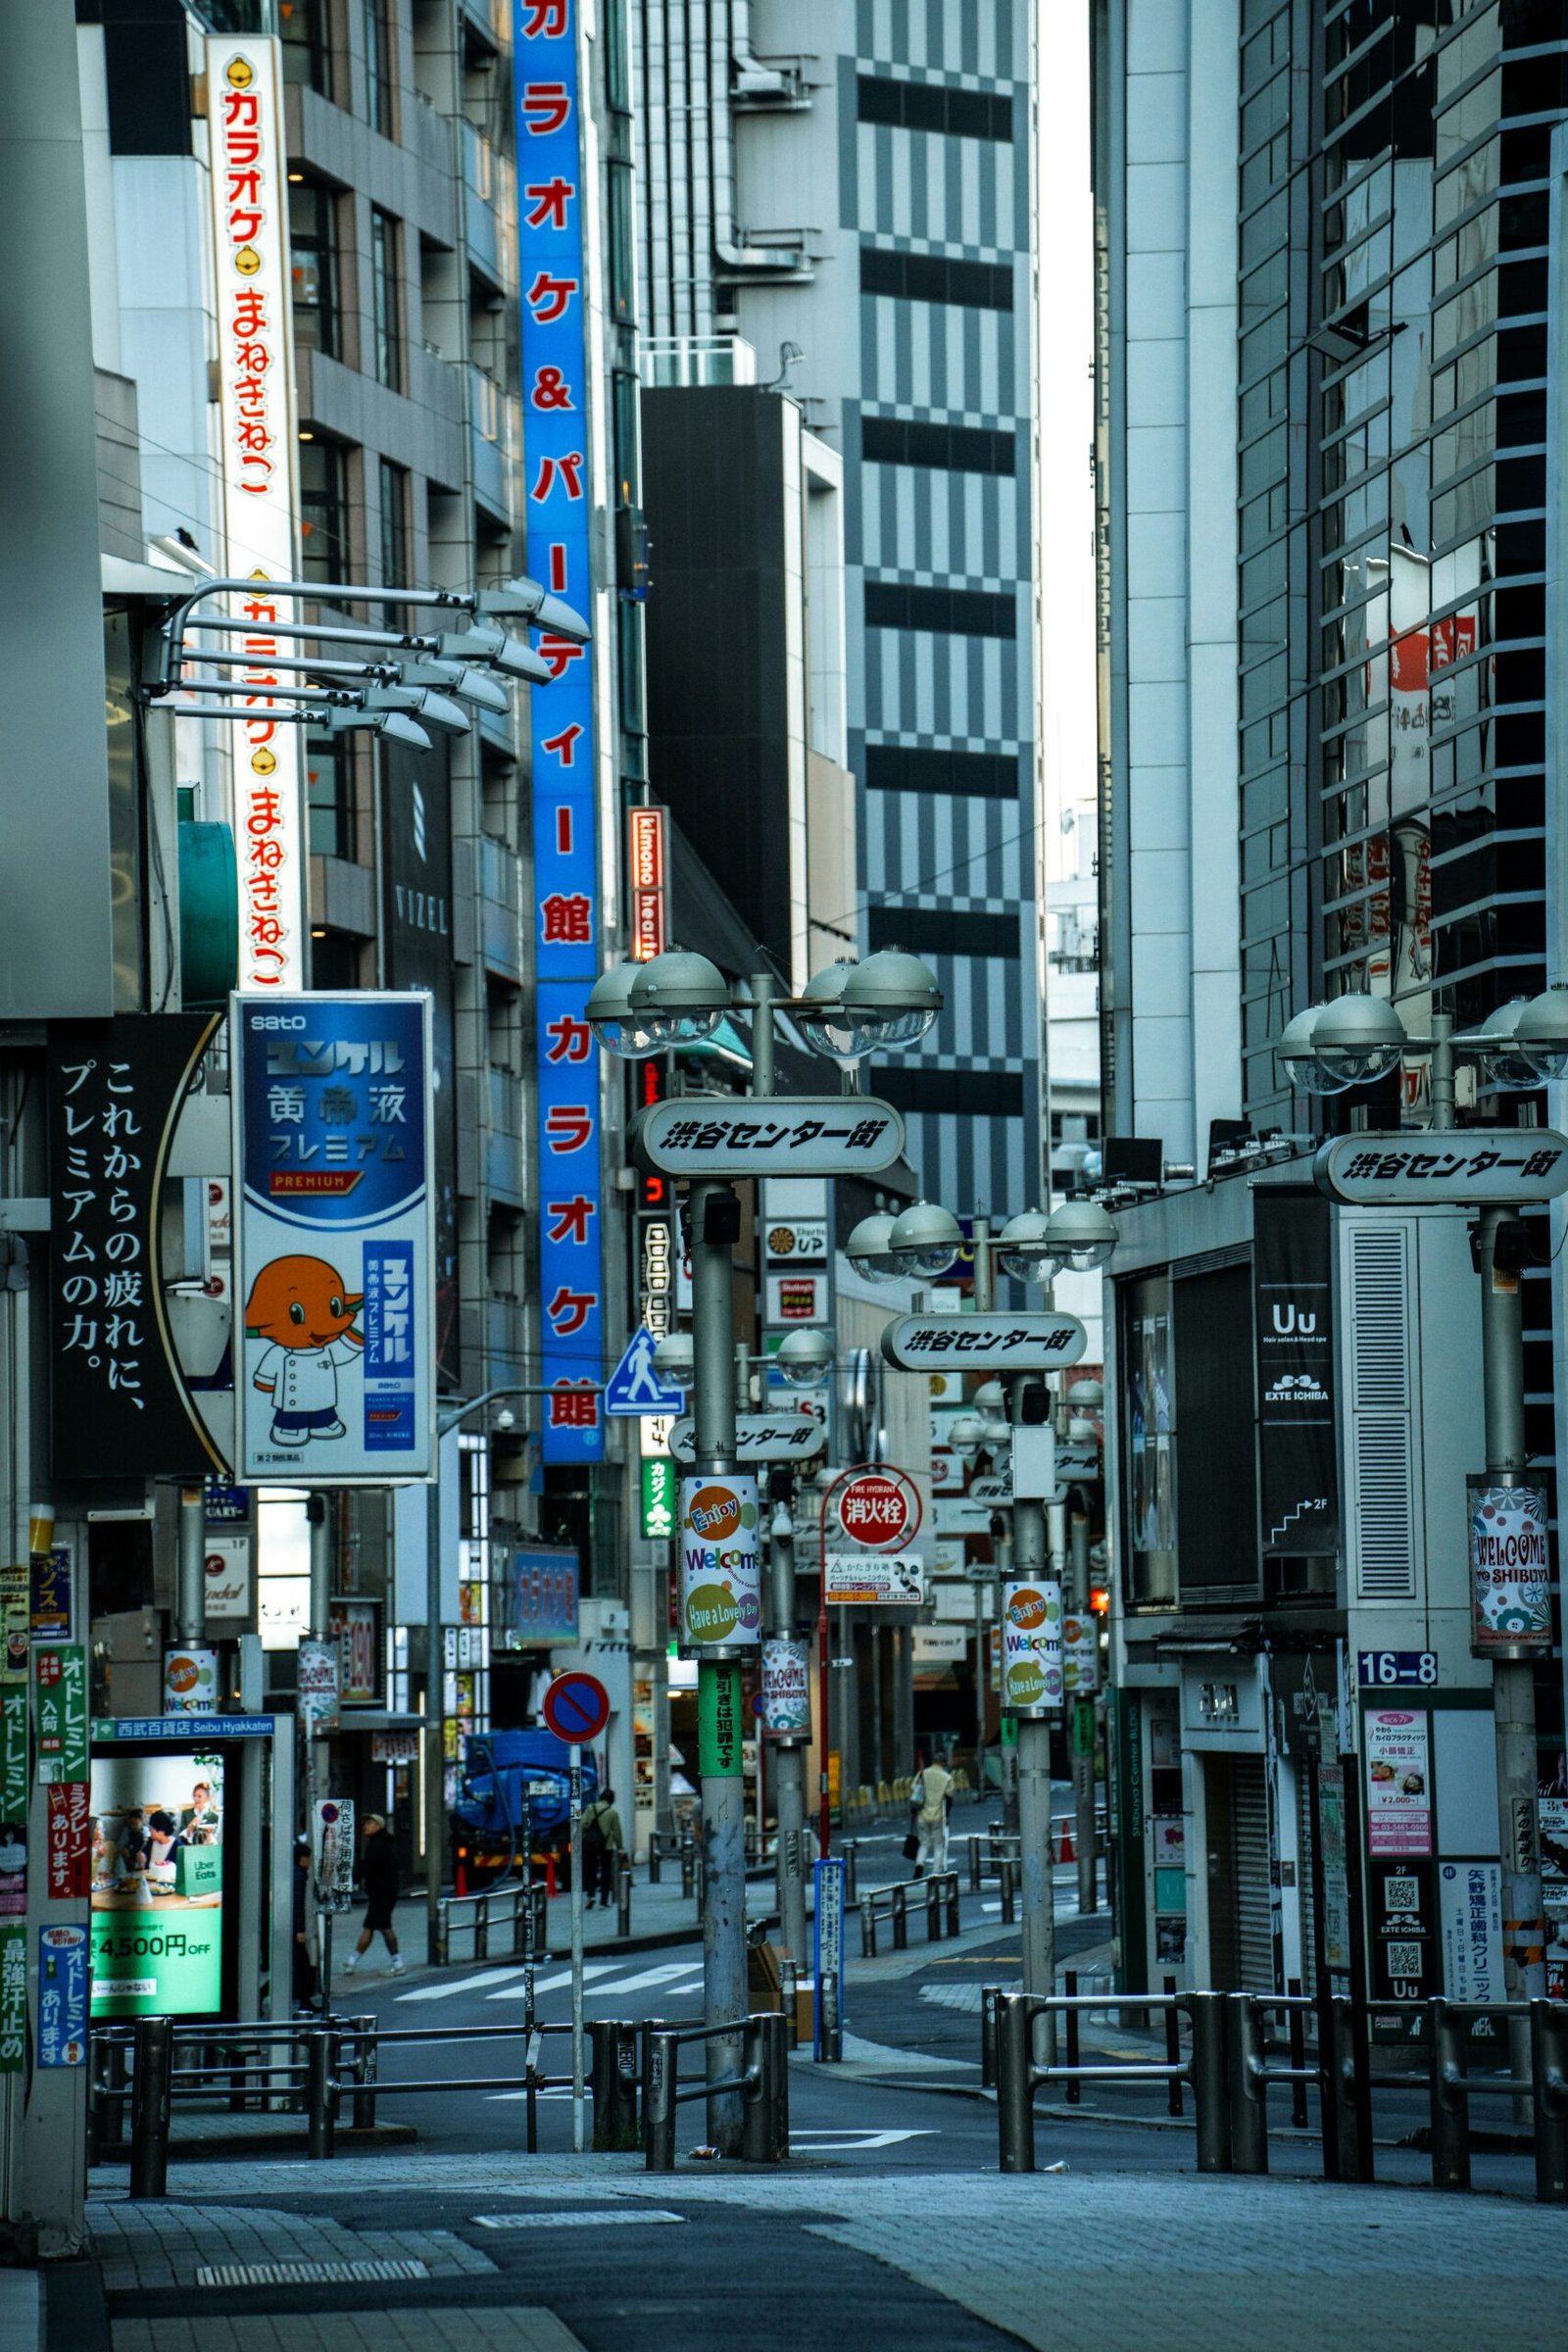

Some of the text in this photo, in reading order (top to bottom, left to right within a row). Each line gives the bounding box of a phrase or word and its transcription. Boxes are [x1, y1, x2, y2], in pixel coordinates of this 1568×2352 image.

[224, 92, 265, 244] カラオケ
[231, 287, 271, 494] まねきねこ
[640, 817, 655, 885] kimono
[245, 786, 285, 985] まねきねこ
[395, 884, 448, 935] VIZEL
[251, 1015, 306, 1030] sato
[267, 1040, 406, 1075] ユンケル
[267, 1085, 407, 1124] 黄帝液
[269, 1134, 406, 1162] プレミアム
[659, 1120, 889, 1151] 渋谷センター街
[1342, 1150, 1561, 1178] 渋谷センター街
[274, 1175, 345, 1189] PREMIUM
[61, 1058, 101, 1369] プレミアムの力。
[545, 1016, 599, 1428] カラオケ館
[103, 1063, 145, 1410] これからの疲れに、
[799, 1238, 823, 1252] UP
[368, 1258, 380, 1364] 黄帝液プレミアム
[383, 1258, 412, 1364] ユンケル
[1272, 1303, 1316, 1334] Uu
[905, 1330, 1076, 1351] 渋谷センター街
[1265, 1391, 1329, 1401] EXTE ICHIBA
[678, 1427, 814, 1448] 渋ンター街
[651, 1461, 666, 1504] カジノ
[851, 1485, 897, 1494] FIRE HYDRANT
[690, 1497, 738, 1534] Enjoy
[846, 1497, 903, 1525] 消火栓
[1313, 1498, 1328, 1510] 2F
[686, 1547, 760, 1571] Welcome
[1477, 1534, 1545, 1566] WELCOME
[1493, 1568, 1549, 1583] SHIBUYA
[689, 1603, 711, 1631] Have
[718, 1603, 746, 1620] Lovely
[746, 1602, 760, 1616] Day
[1009, 1598, 1045, 1624] Enjoy
[1361, 1652, 1437, 1685] 16-8
[40, 1698, 58, 1733] 入荷
[62, 1656, 85, 1772] オドレミン
[165, 1696, 216, 1712] Welcome
[716, 1667, 734, 1770] 客引きは犯罪です
[118, 1720, 273, 1738] 西武百貨店 Seibu Hyakkaten
[4, 1693, 26, 1812] オドレミン
[1130, 1742, 1140, 1786] Center
[70, 1784, 87, 1858] ミラグレーン
[1131, 1788, 1142, 1838] Shibuya
[195, 1871, 217, 1881] Eats
[1395, 1866, 1407, 1875] 2F
[1381, 1926, 1427, 1935] EXTE ICHIBA
[1468, 1869, 1492, 2002] 矢野矯正歯科クリニック
[0, 1937, 26, 2059] 最強汗止め
[66, 1947, 85, 2041] オドレミン
[1393, 1980, 1419, 1999] Uu
[41, 1989, 61, 2064] あります
[619, 2043, 634, 2070] NERO
